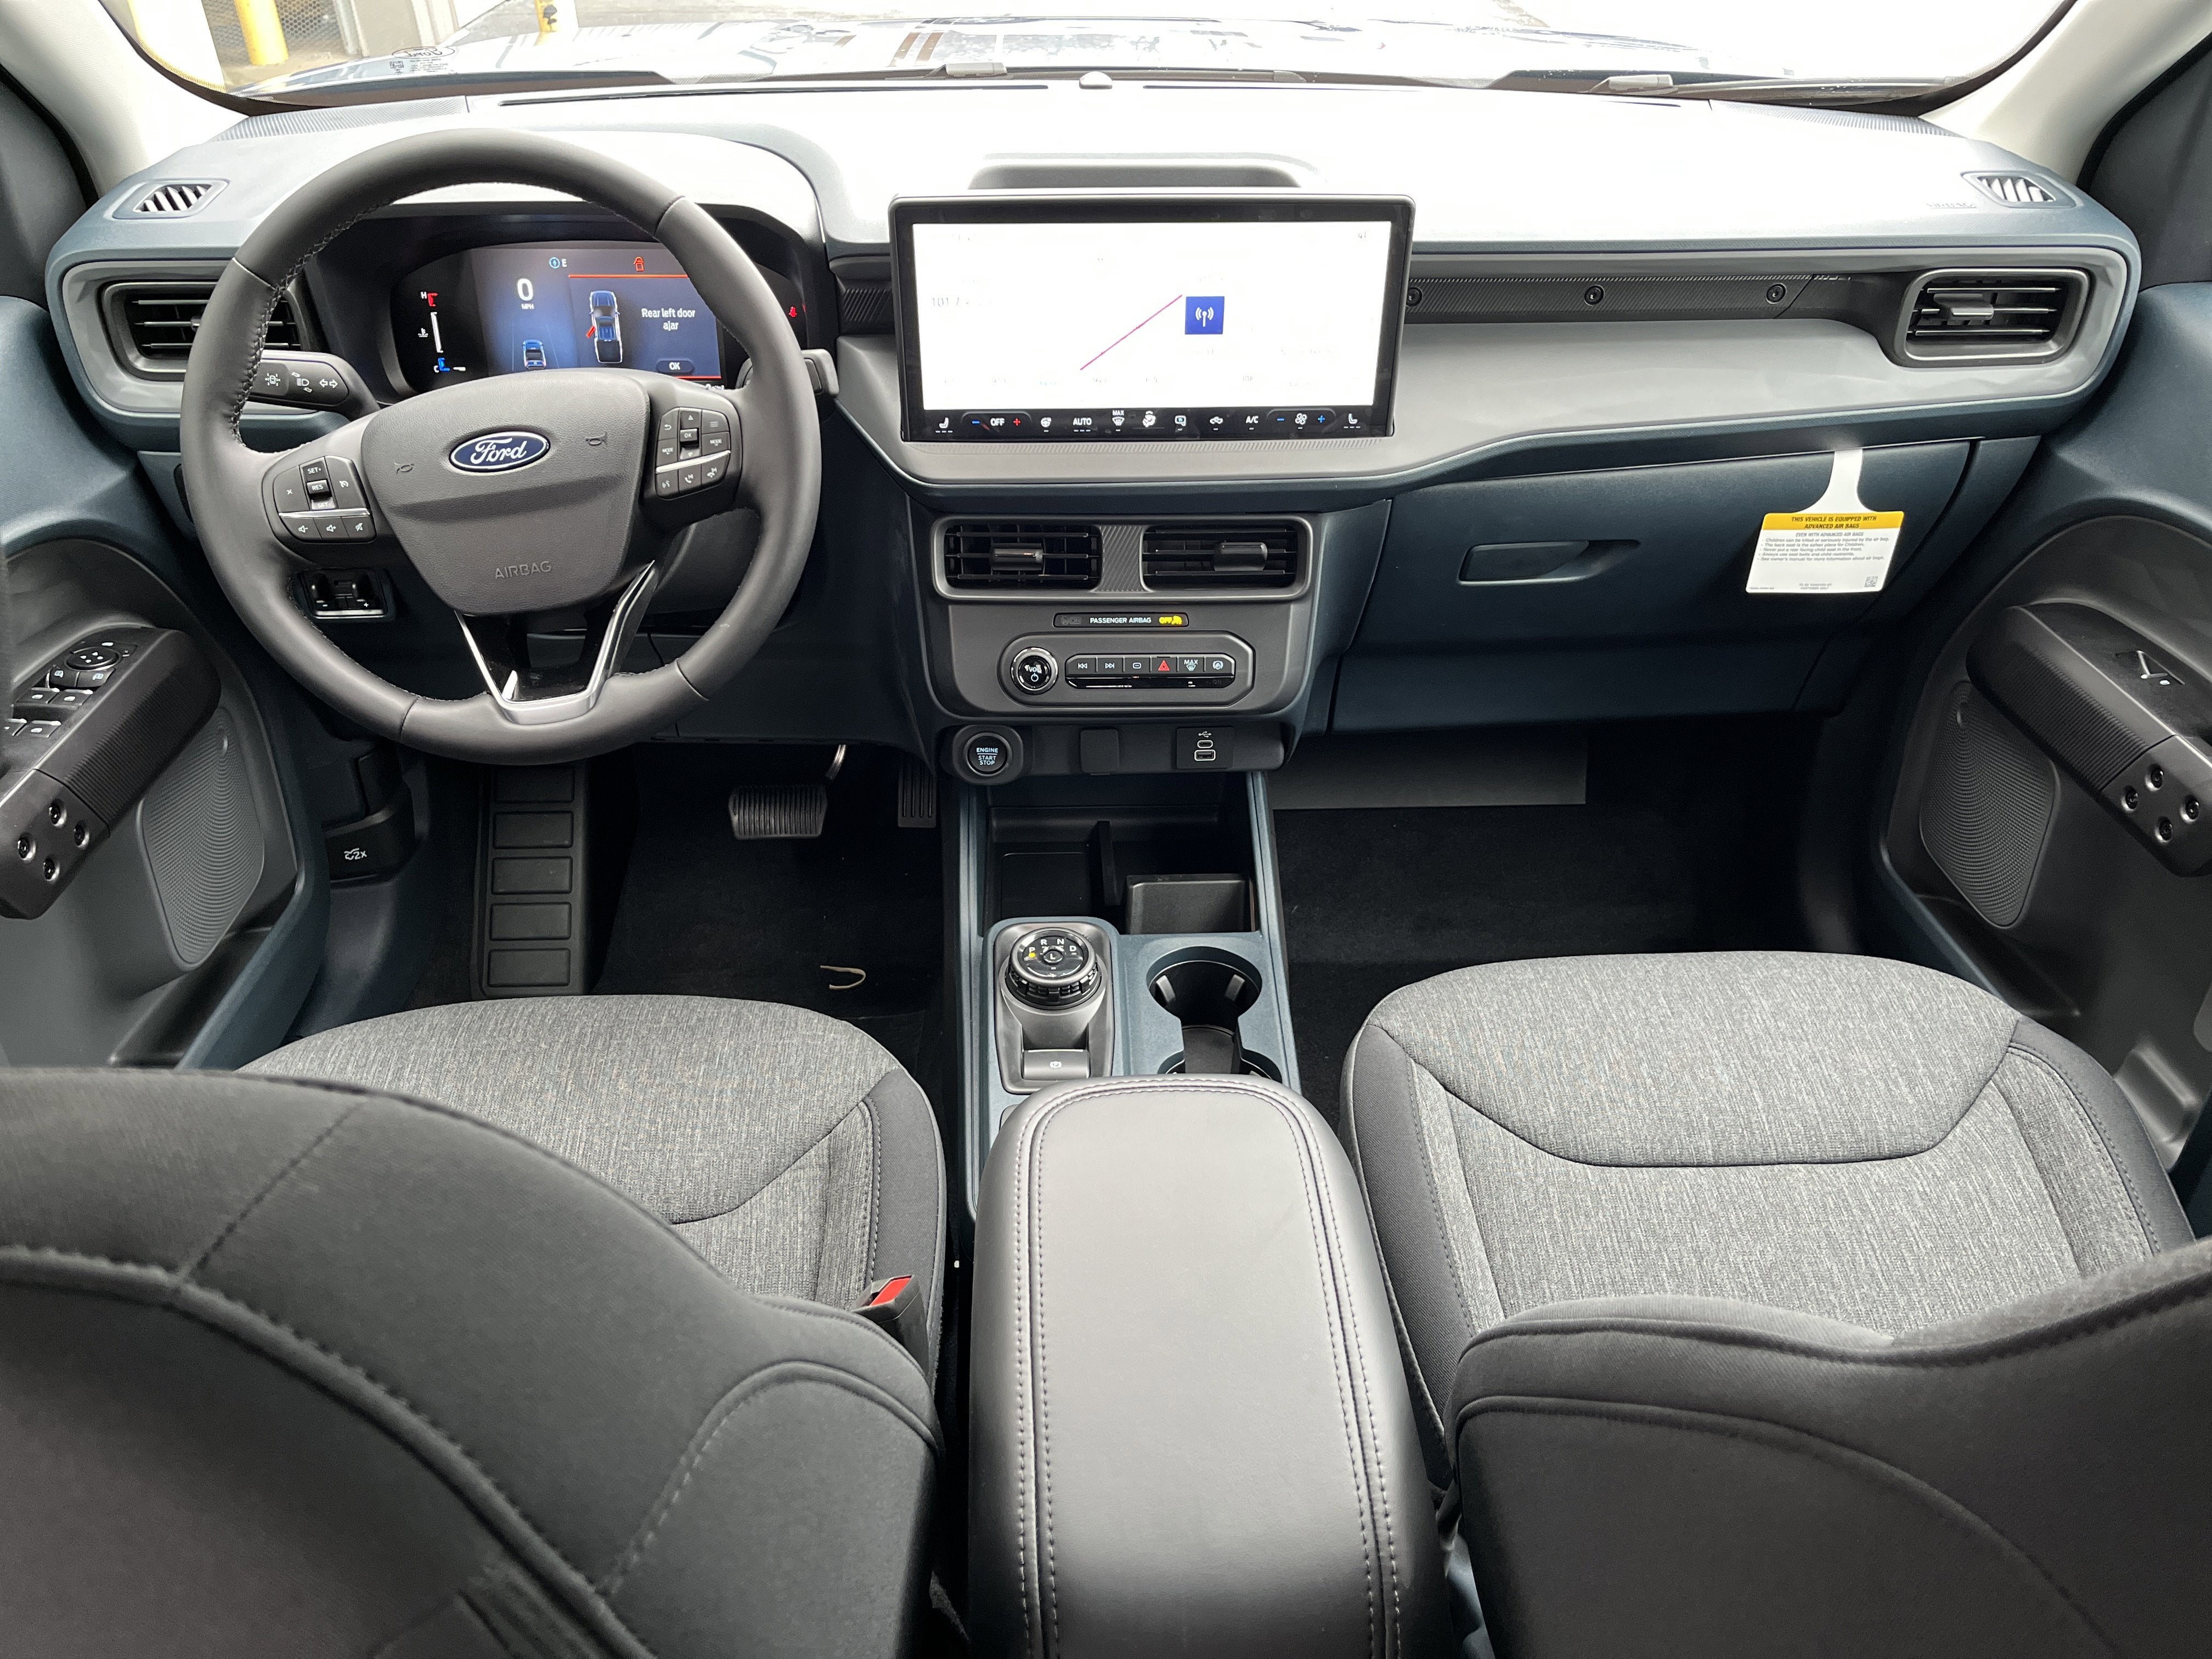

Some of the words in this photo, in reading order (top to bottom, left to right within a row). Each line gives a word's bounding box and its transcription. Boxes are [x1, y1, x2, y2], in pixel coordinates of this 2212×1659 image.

[561, 258, 567, 267] E
[517, 278, 533, 302] 0
[641, 308, 661, 318] Rear
[662, 308, 676, 318] left
[677, 308, 695, 318] door
[663, 320, 679, 331] ajar
[669, 362, 681, 370] OK
[990, 417, 1005, 426] OFF
[1073, 417, 1092, 426] AUTO
[470, 438, 527, 464] Ford
[495, 561, 552, 579] AIRBAG
